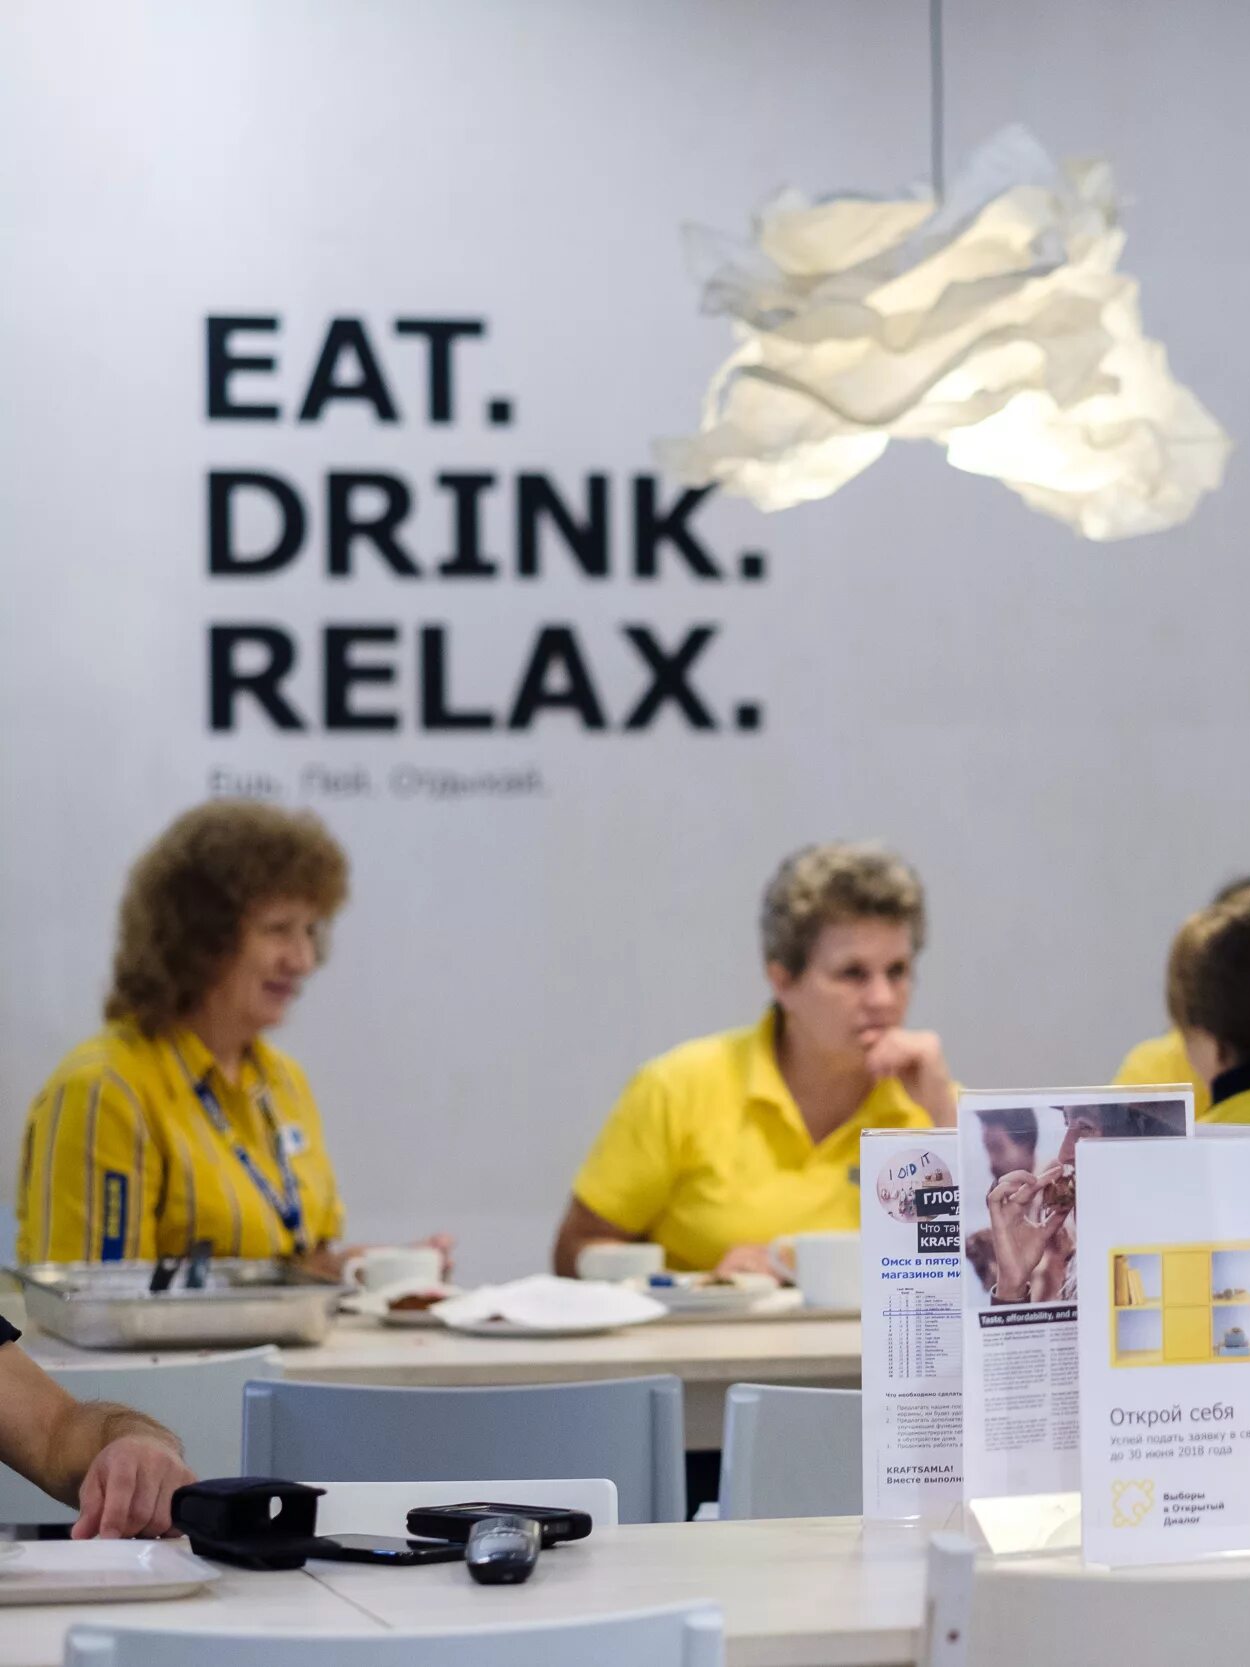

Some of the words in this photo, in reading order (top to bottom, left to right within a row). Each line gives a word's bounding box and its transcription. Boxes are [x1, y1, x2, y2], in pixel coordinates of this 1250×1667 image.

[205, 315, 513, 424] EAT.
[206, 470, 768, 579] DRINK.
[207, 624, 763, 731] RELAX.
[920, 1152, 930, 1167] IT
[920, 1223, 940, 1233] Что
[881, 1257, 912, 1266] Омск
[925, 1257, 959, 1268] пятер
[881, 1270, 944, 1280] магазинов
[1055, 1310, 1071, 1319] and
[1110, 1405, 1182, 1427] Открой
[1190, 1402, 1234, 1422] себя
[1110, 1434, 1142, 1446] Успей
[1146, 1434, 1184, 1446] подать
[1188, 1431, 1226, 1442] заявку
[1230, 1431, 1236, 1439] в
[1110, 1452, 1124, 1462] до
[1128, 1449, 1142, 1460] 30
[1146, 1450, 1174, 1459] июня
[1178, 1446, 1205, 1458] 2018
[1208, 1446, 1233, 1457] года
[886, 1465, 954, 1474] KRAFTSAMLA!
[886, 1476, 921, 1485] Вместе
[1163, 1491, 1206, 1502] Выборы
[1172, 1502, 1225, 1513] Открытый
[1163, 1515, 1201, 1527] Диалог
